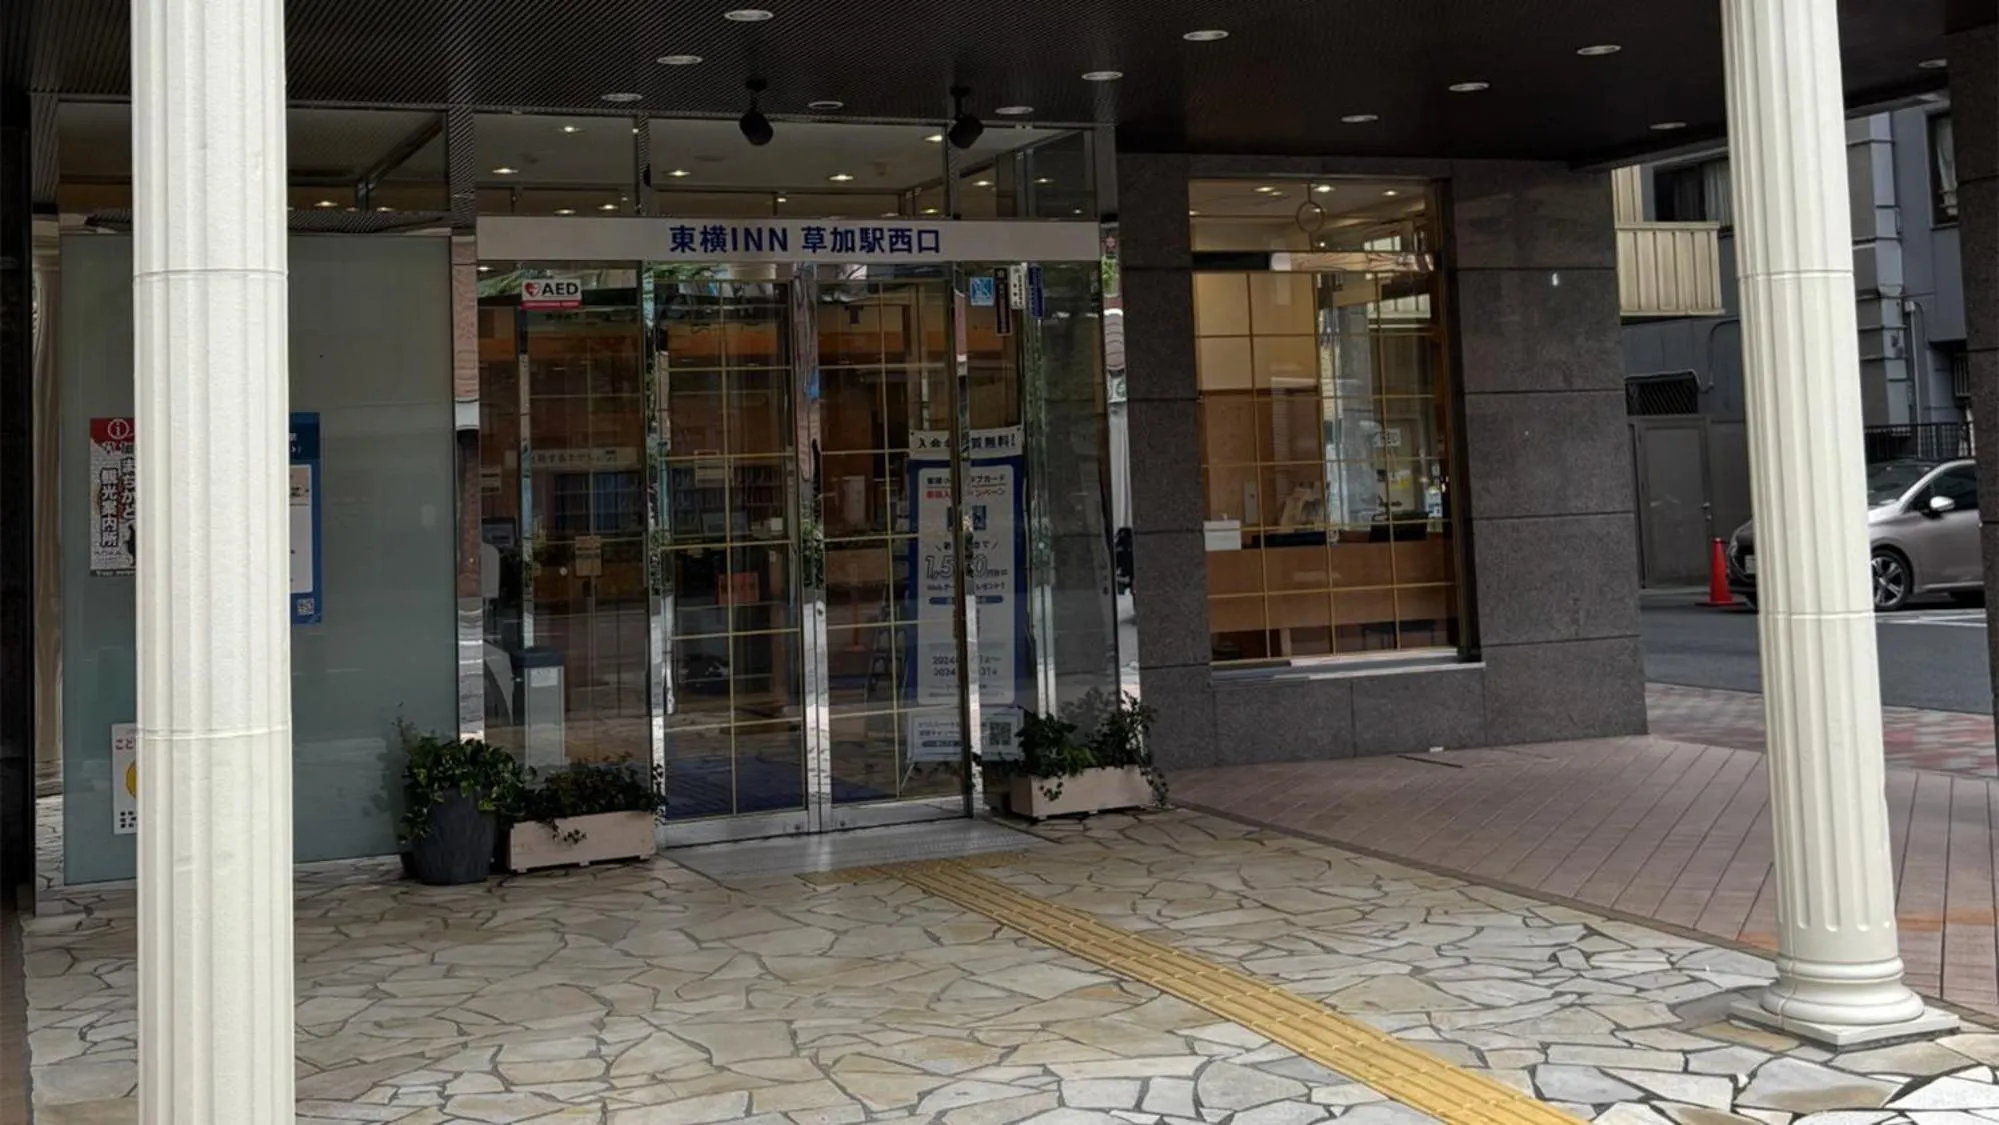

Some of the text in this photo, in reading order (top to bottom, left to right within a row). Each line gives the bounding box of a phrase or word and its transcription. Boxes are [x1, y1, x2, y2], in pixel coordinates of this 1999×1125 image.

[669, 224, 941, 253] 東横INN 草加駅西口
[542, 283, 579, 296] AED
